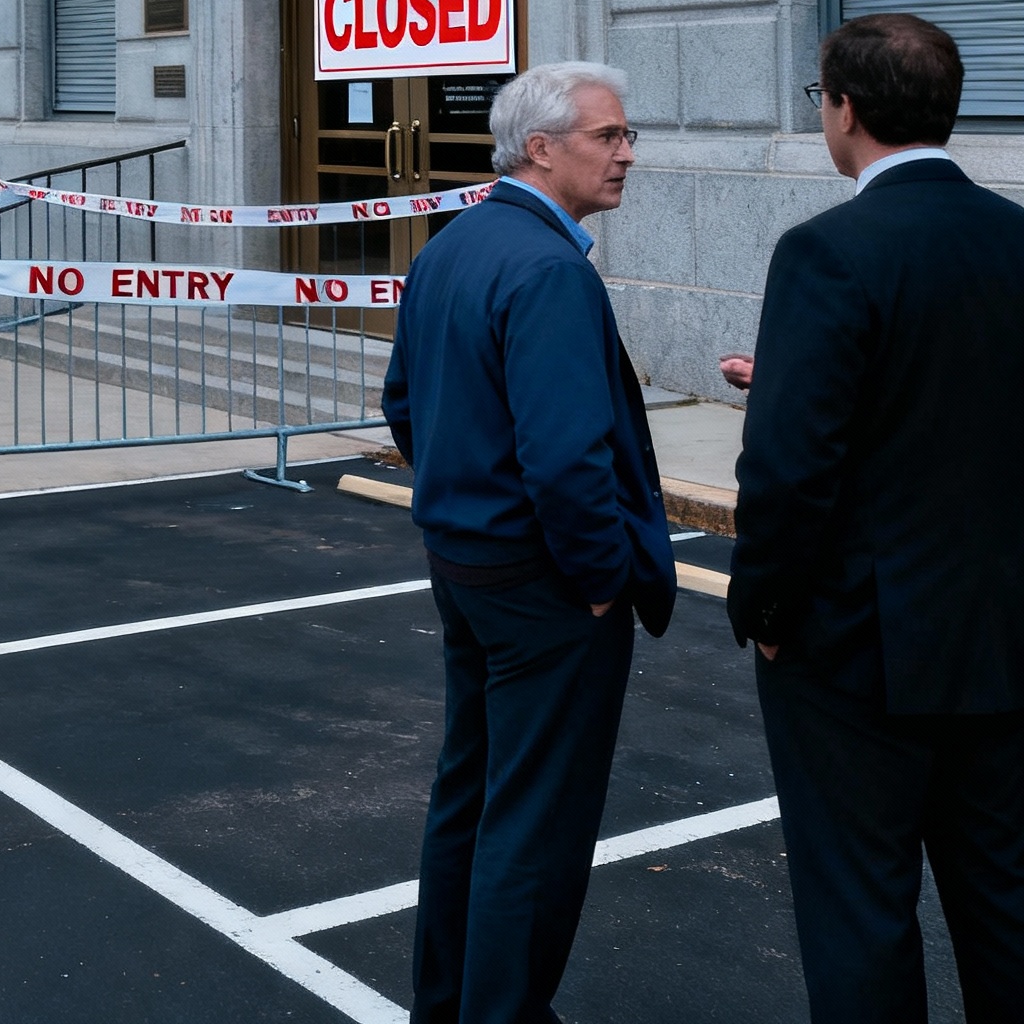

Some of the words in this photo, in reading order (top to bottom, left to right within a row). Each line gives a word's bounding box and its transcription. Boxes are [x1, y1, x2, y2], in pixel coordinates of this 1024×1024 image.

[352, 202, 391, 219] NO
[29, 266, 84, 296] NO
[112, 269, 234, 301] ENTRY
[295, 277, 349, 303] NO
